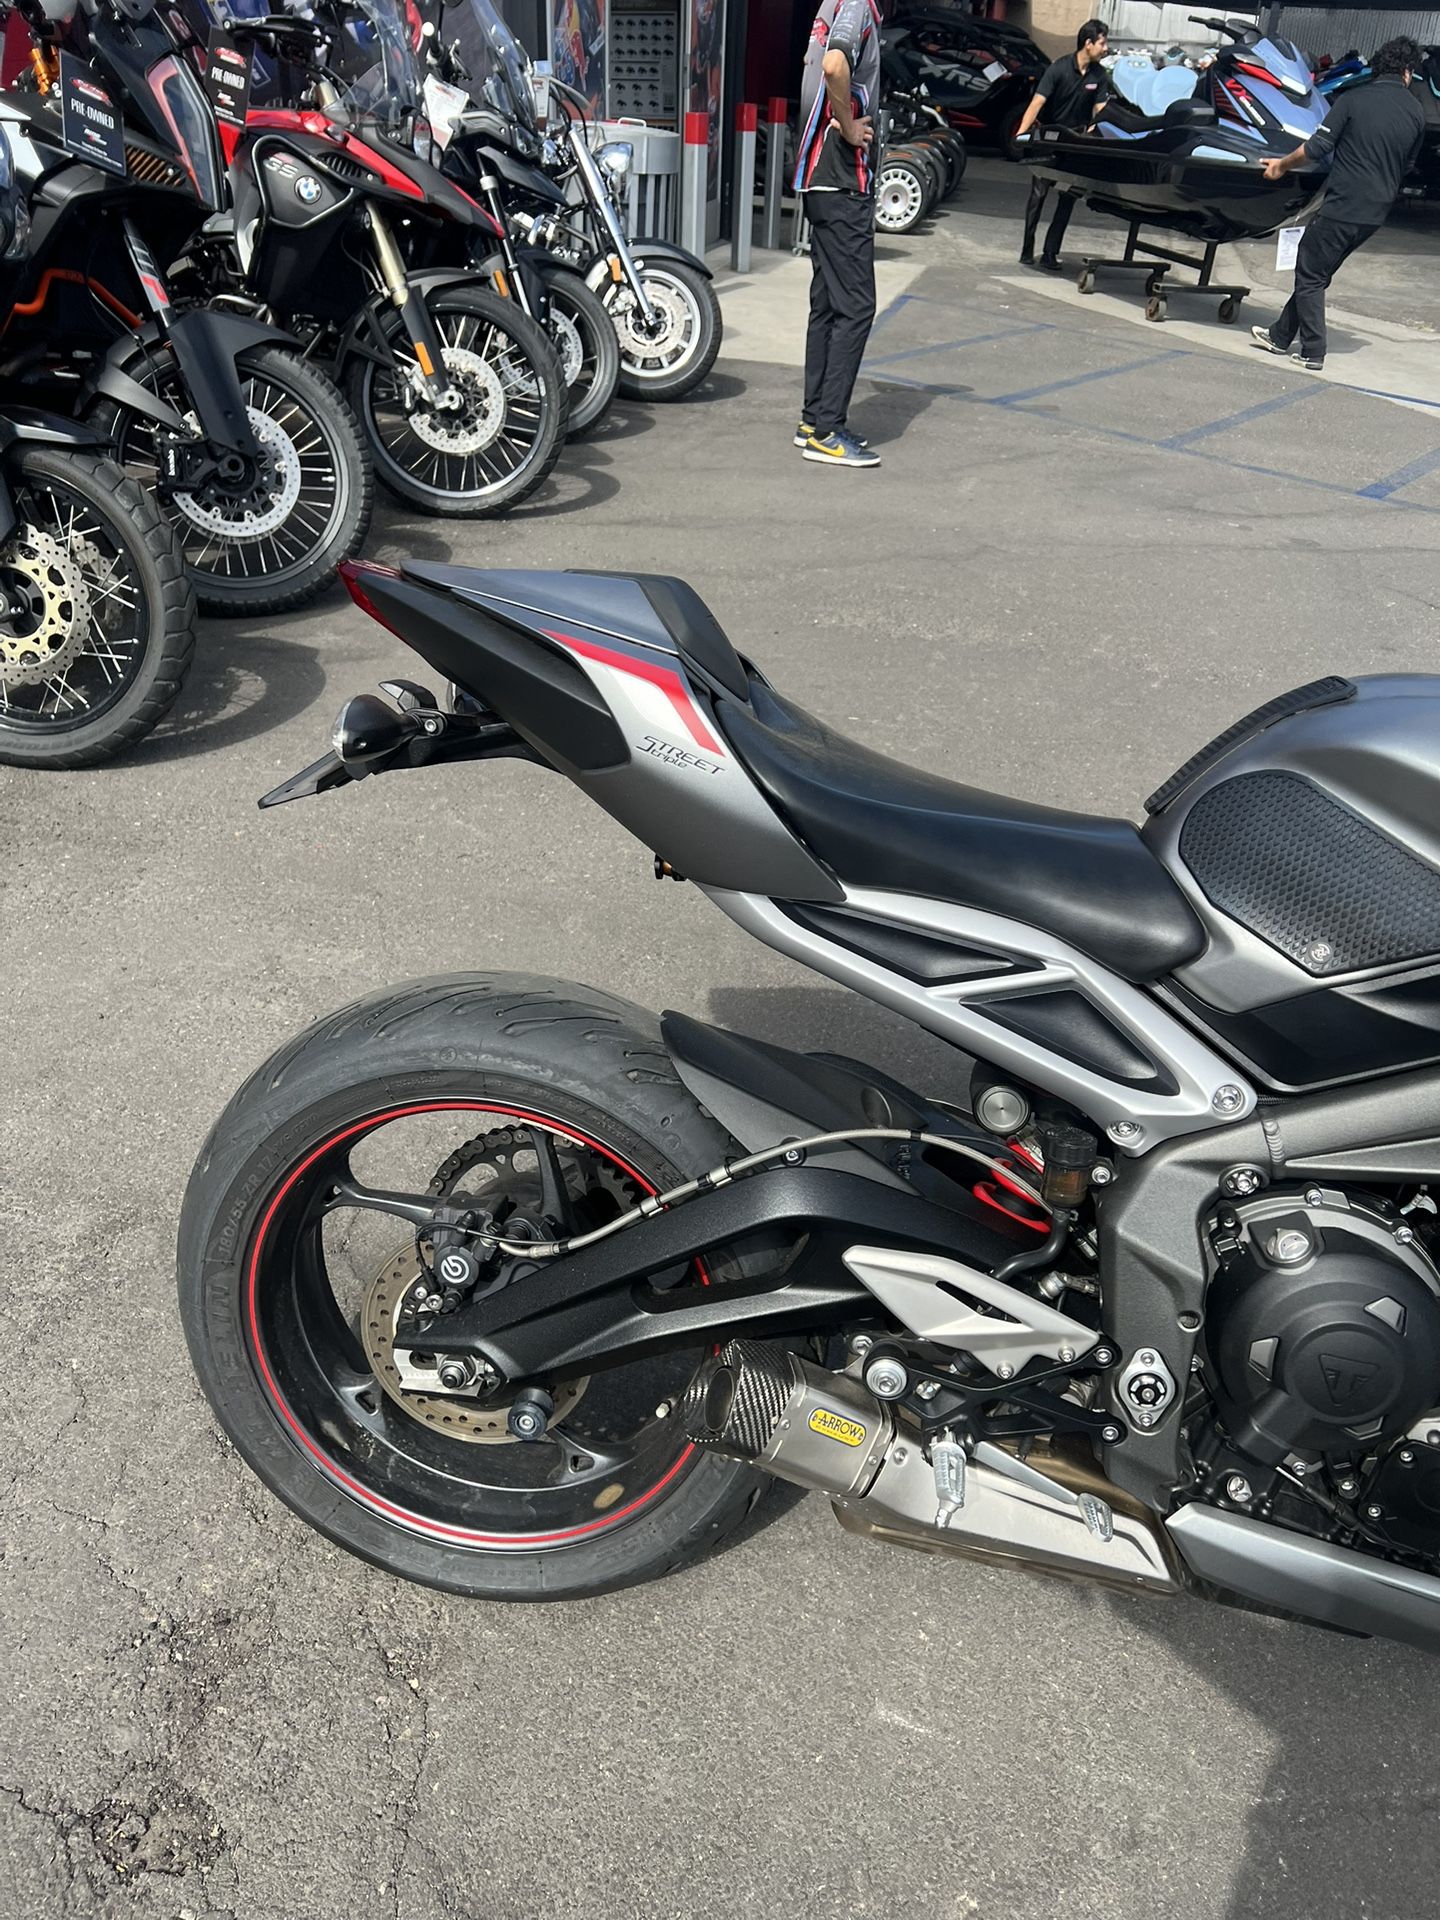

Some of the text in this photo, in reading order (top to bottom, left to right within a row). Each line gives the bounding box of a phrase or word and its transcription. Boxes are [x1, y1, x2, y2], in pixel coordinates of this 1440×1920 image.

[211, 66, 245, 90] PRE-OWNED
[71, 97, 114, 129] PRE-OWNED
[635, 735, 726, 774] STREET
[818, 1412, 862, 1438] ARROW
